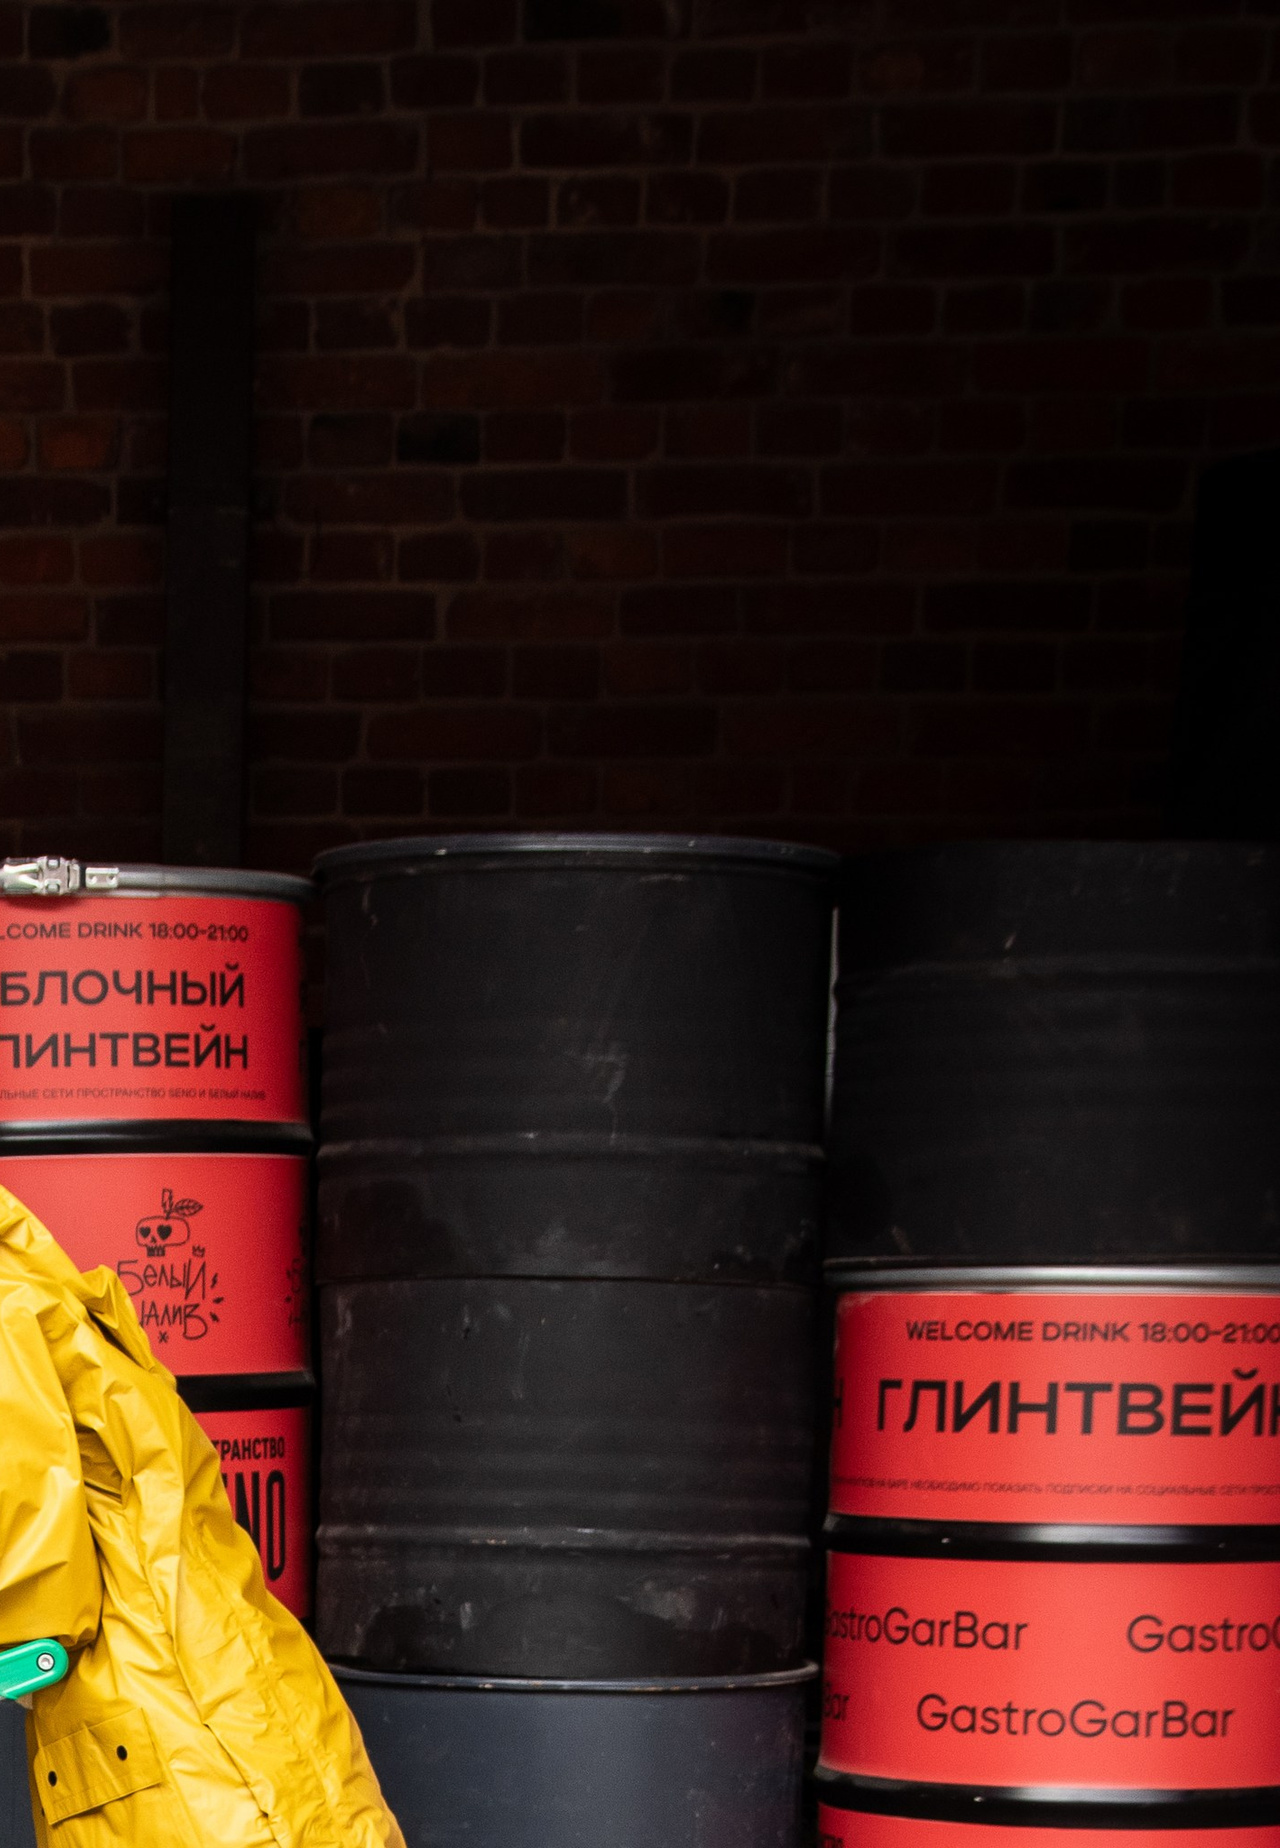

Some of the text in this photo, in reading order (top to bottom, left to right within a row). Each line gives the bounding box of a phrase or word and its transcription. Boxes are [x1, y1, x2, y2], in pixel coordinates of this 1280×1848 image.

[78, 922, 142, 938] DRINK
[149, 923, 248, 942] 18:00-21:00
[42, 1088, 74, 1099] СЕТИ
[77, 1087, 166, 1099] ПРОСТРАНСТВО
[906, 1320, 1033, 1342] WELCOME
[1041, 1321, 1129, 1343] DRINK
[876, 1368, 1280, 1438] ГЛИНТВЕЙ
[825, 1606, 1028, 1650] astroGarBar
[917, 1692, 1236, 1739] GastroGarBar
